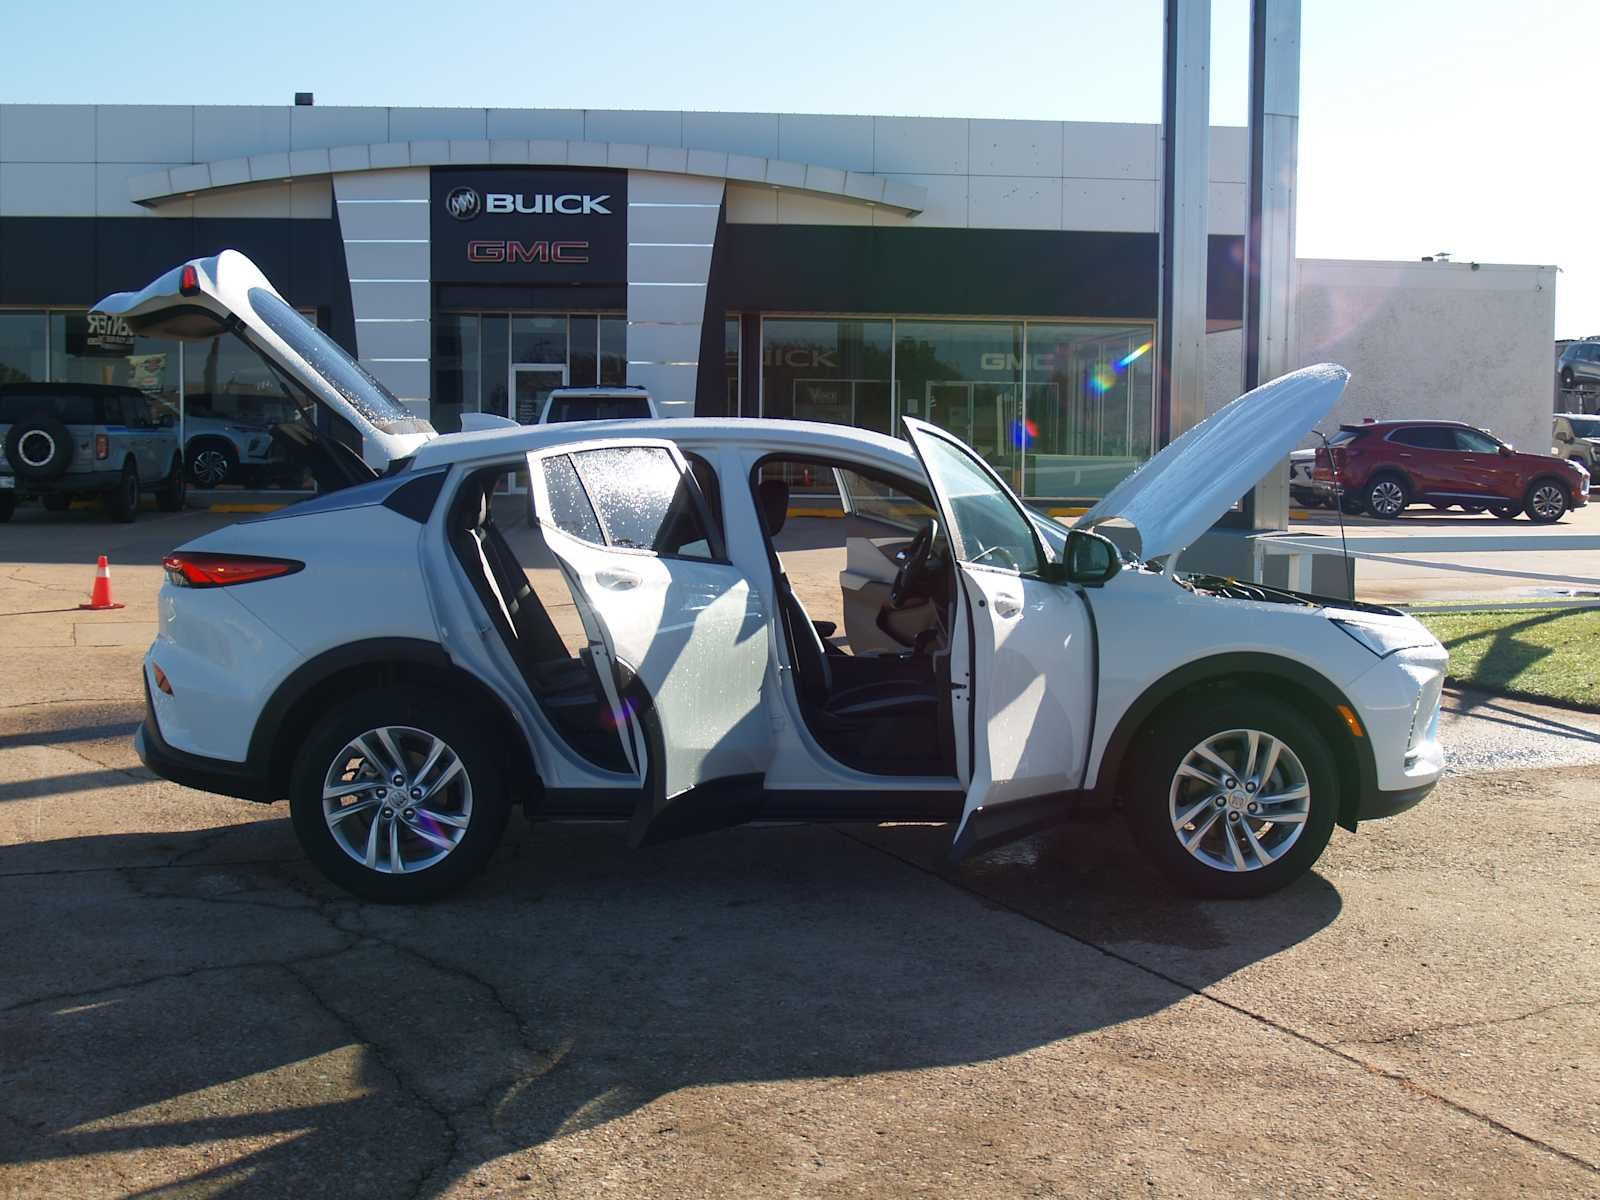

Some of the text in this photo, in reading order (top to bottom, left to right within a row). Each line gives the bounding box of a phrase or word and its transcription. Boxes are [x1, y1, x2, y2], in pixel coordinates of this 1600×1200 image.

[486, 193, 612, 214] BUICK
[467, 239, 589, 263] GMC
[980, 352, 1055, 370] GMC
